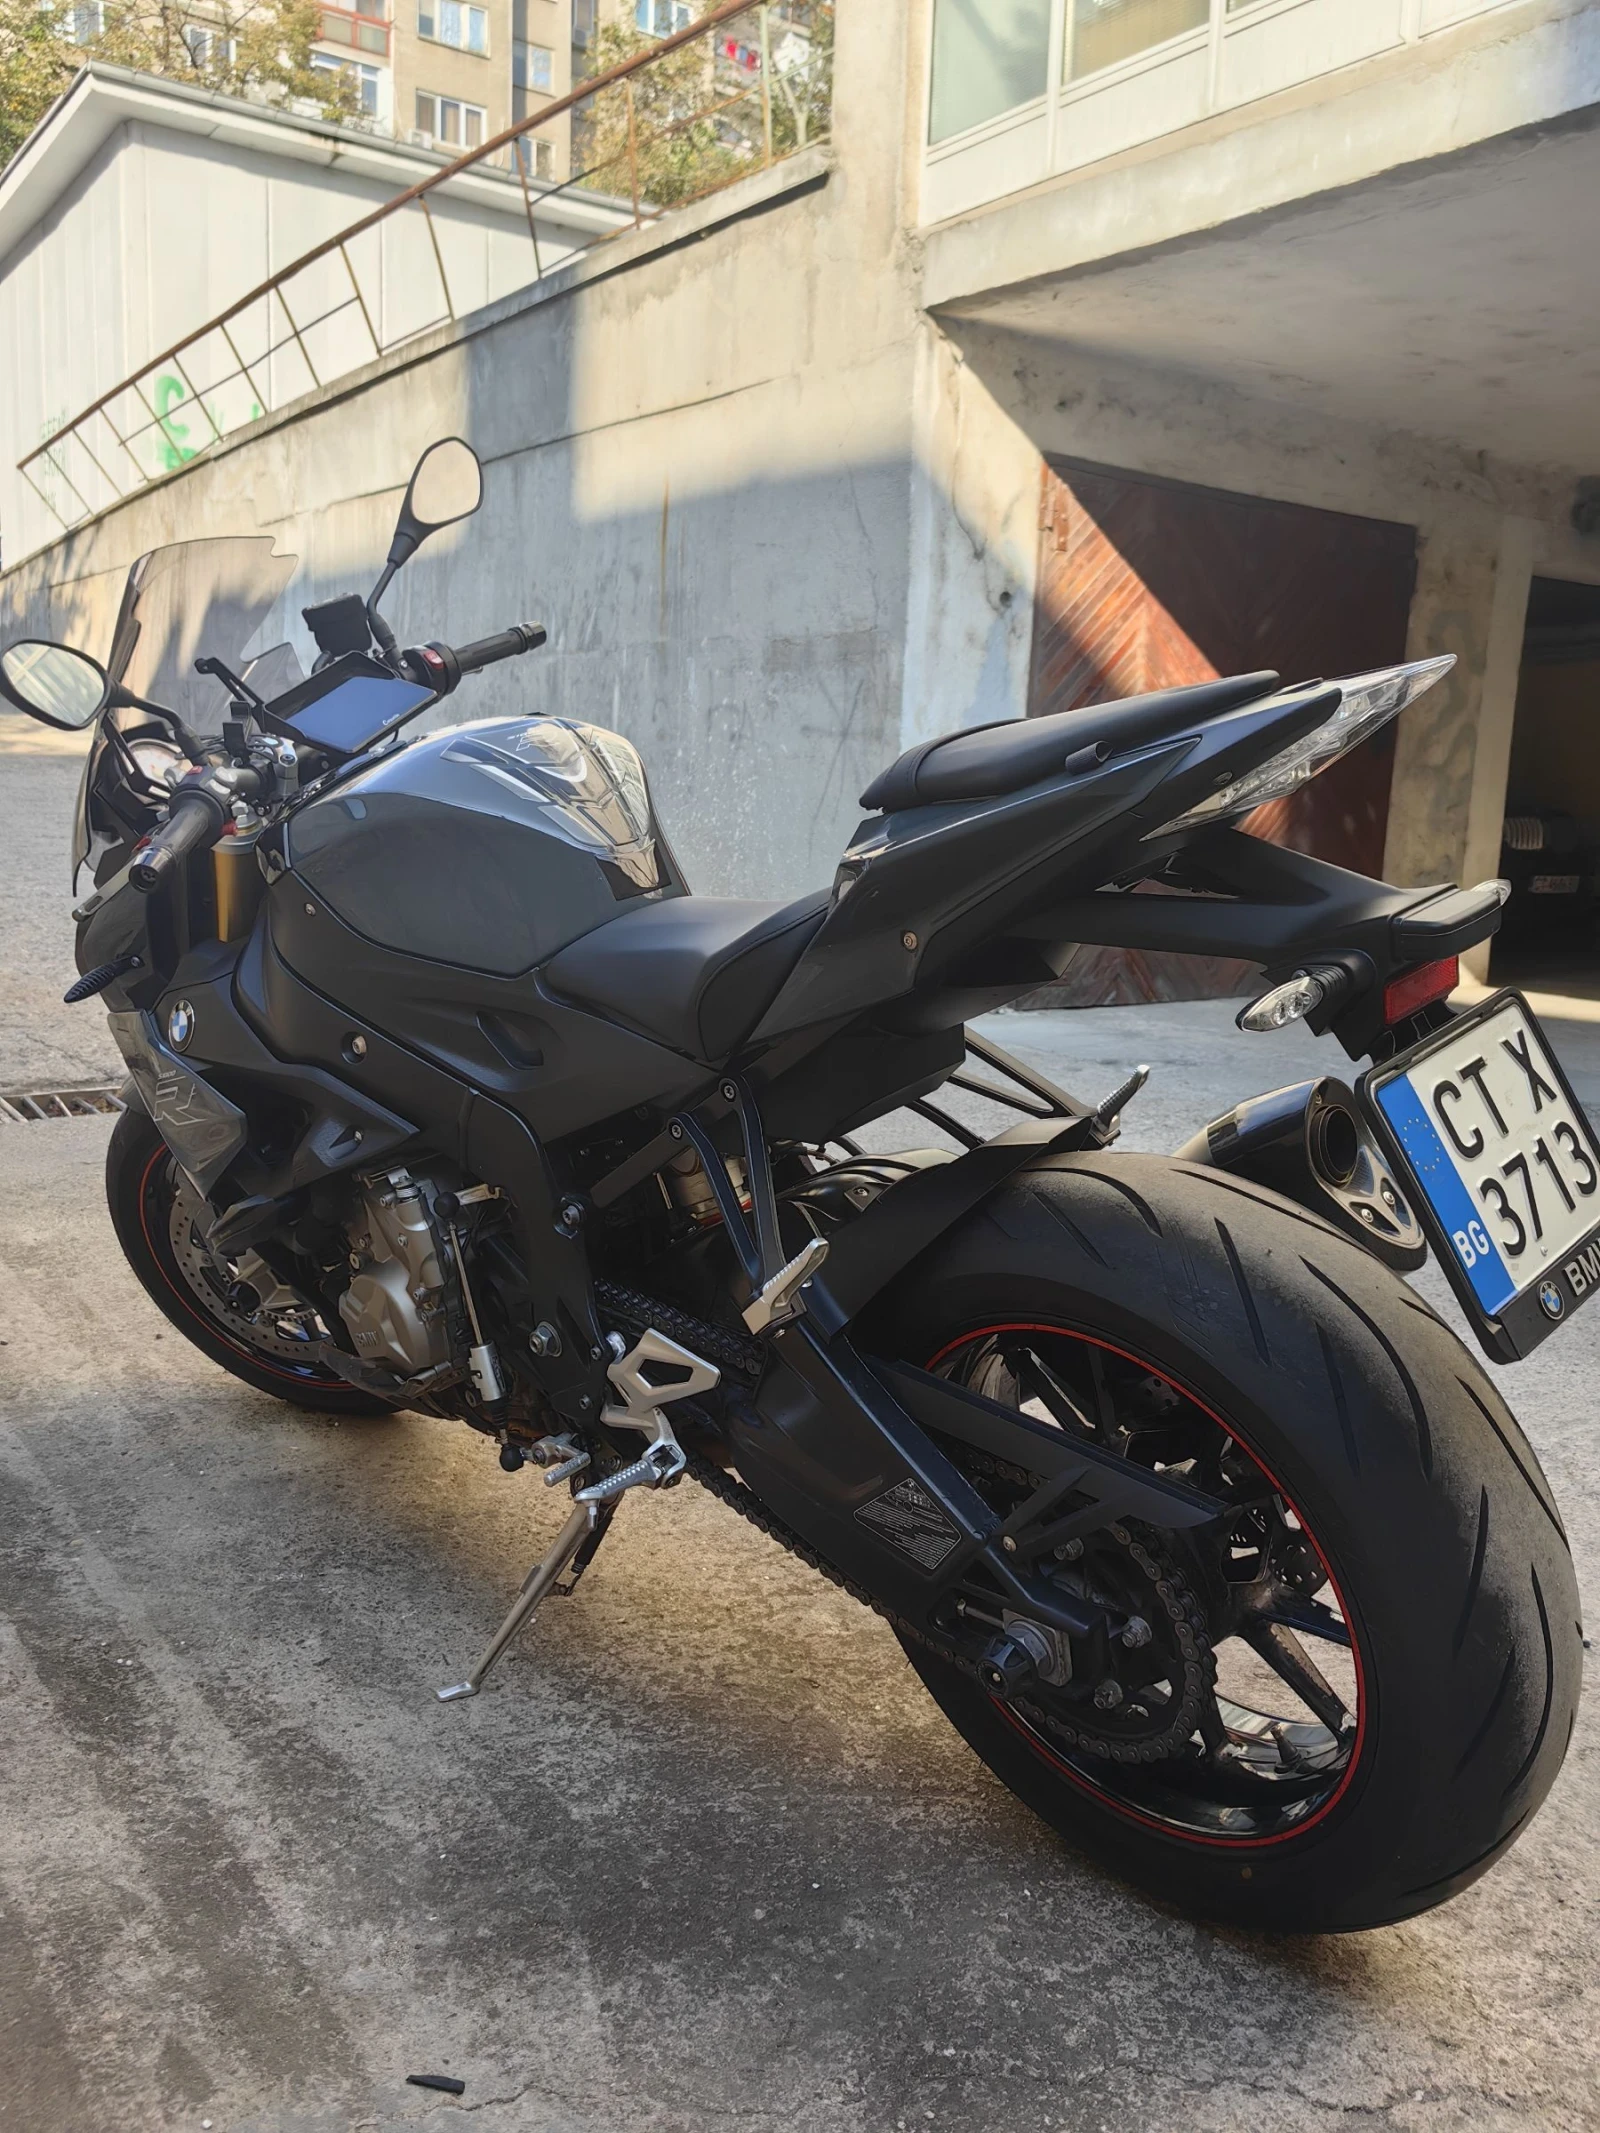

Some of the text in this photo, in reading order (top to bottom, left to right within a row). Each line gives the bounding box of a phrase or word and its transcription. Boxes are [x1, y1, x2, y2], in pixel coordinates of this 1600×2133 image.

[1433, 1029, 1557, 1159] CT X
[1453, 1219, 1489, 1269] BG
[1479, 1121, 1597, 1256] 3713
